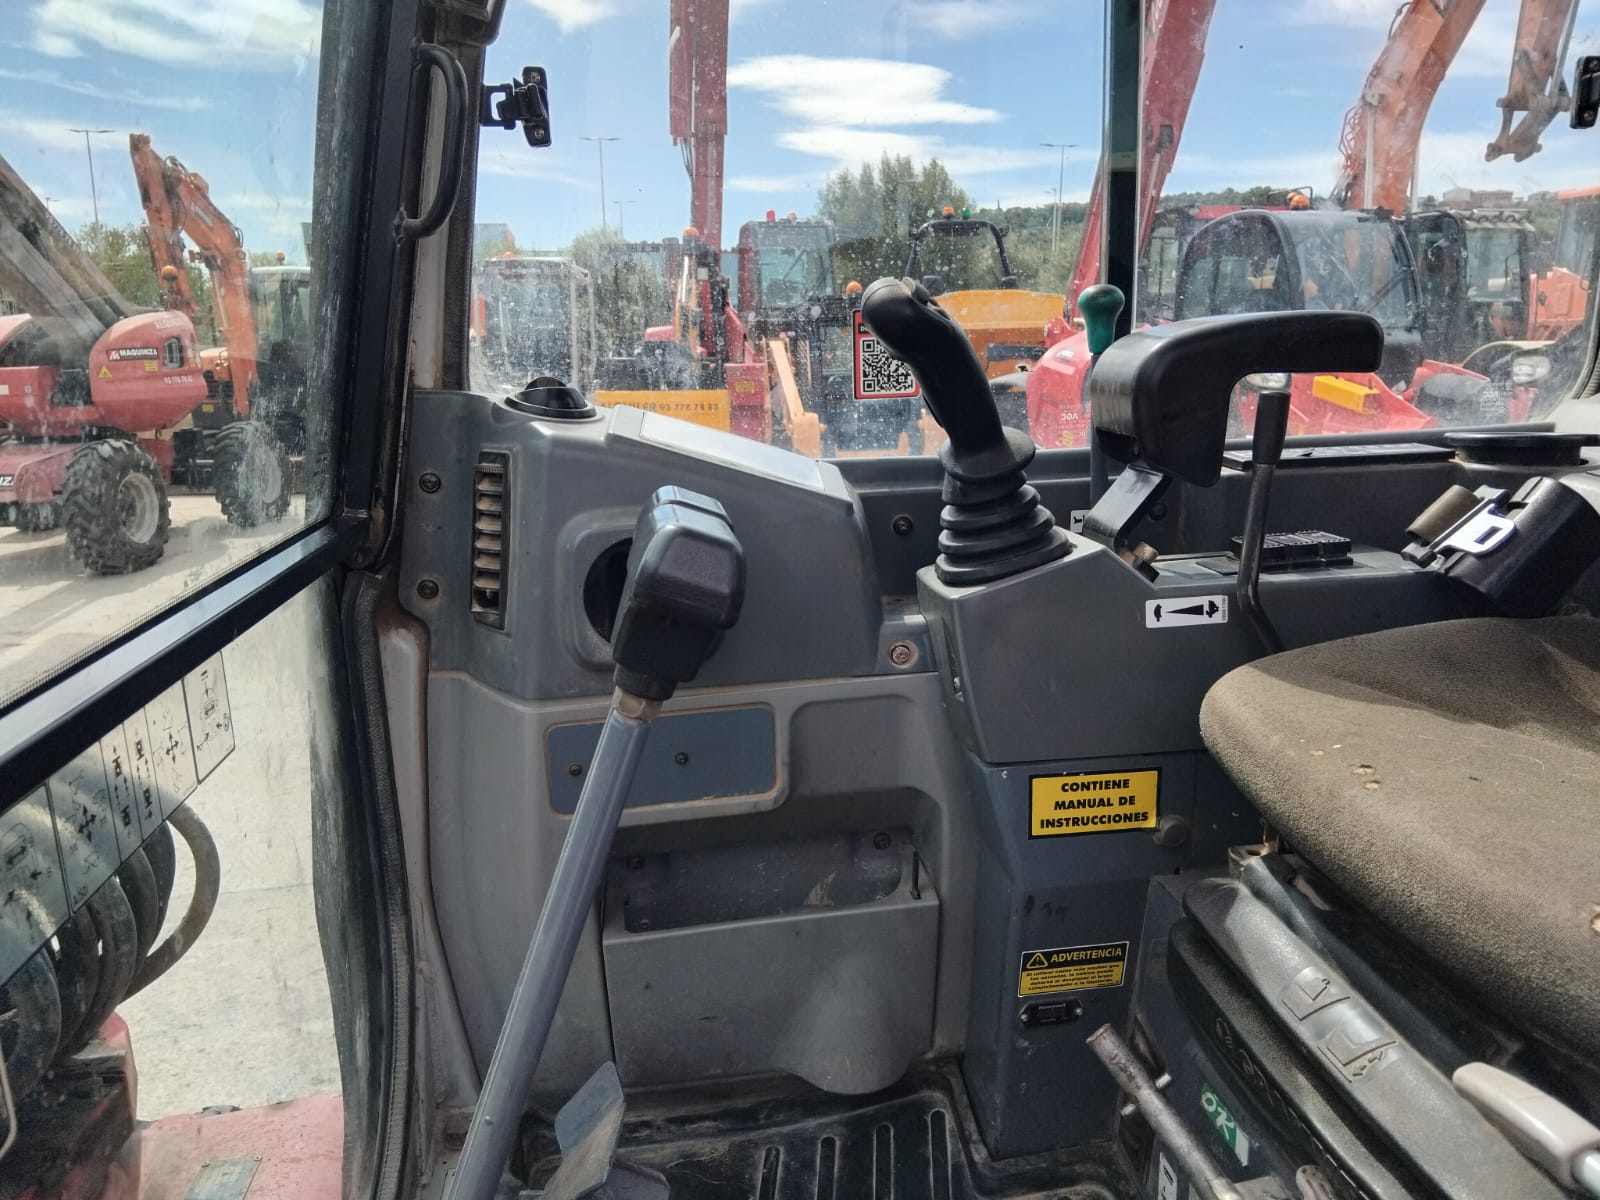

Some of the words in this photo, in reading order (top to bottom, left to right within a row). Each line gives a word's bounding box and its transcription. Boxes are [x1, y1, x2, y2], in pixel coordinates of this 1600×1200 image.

[1061, 779, 1130, 792] CONTIENE
[1054, 797, 1114, 810] MANUAL
[1118, 796, 1136, 806] DE
[1040, 812, 1149, 829] INSTRUCCIONES
[1050, 948, 1122, 963] ADVERTENCIA
